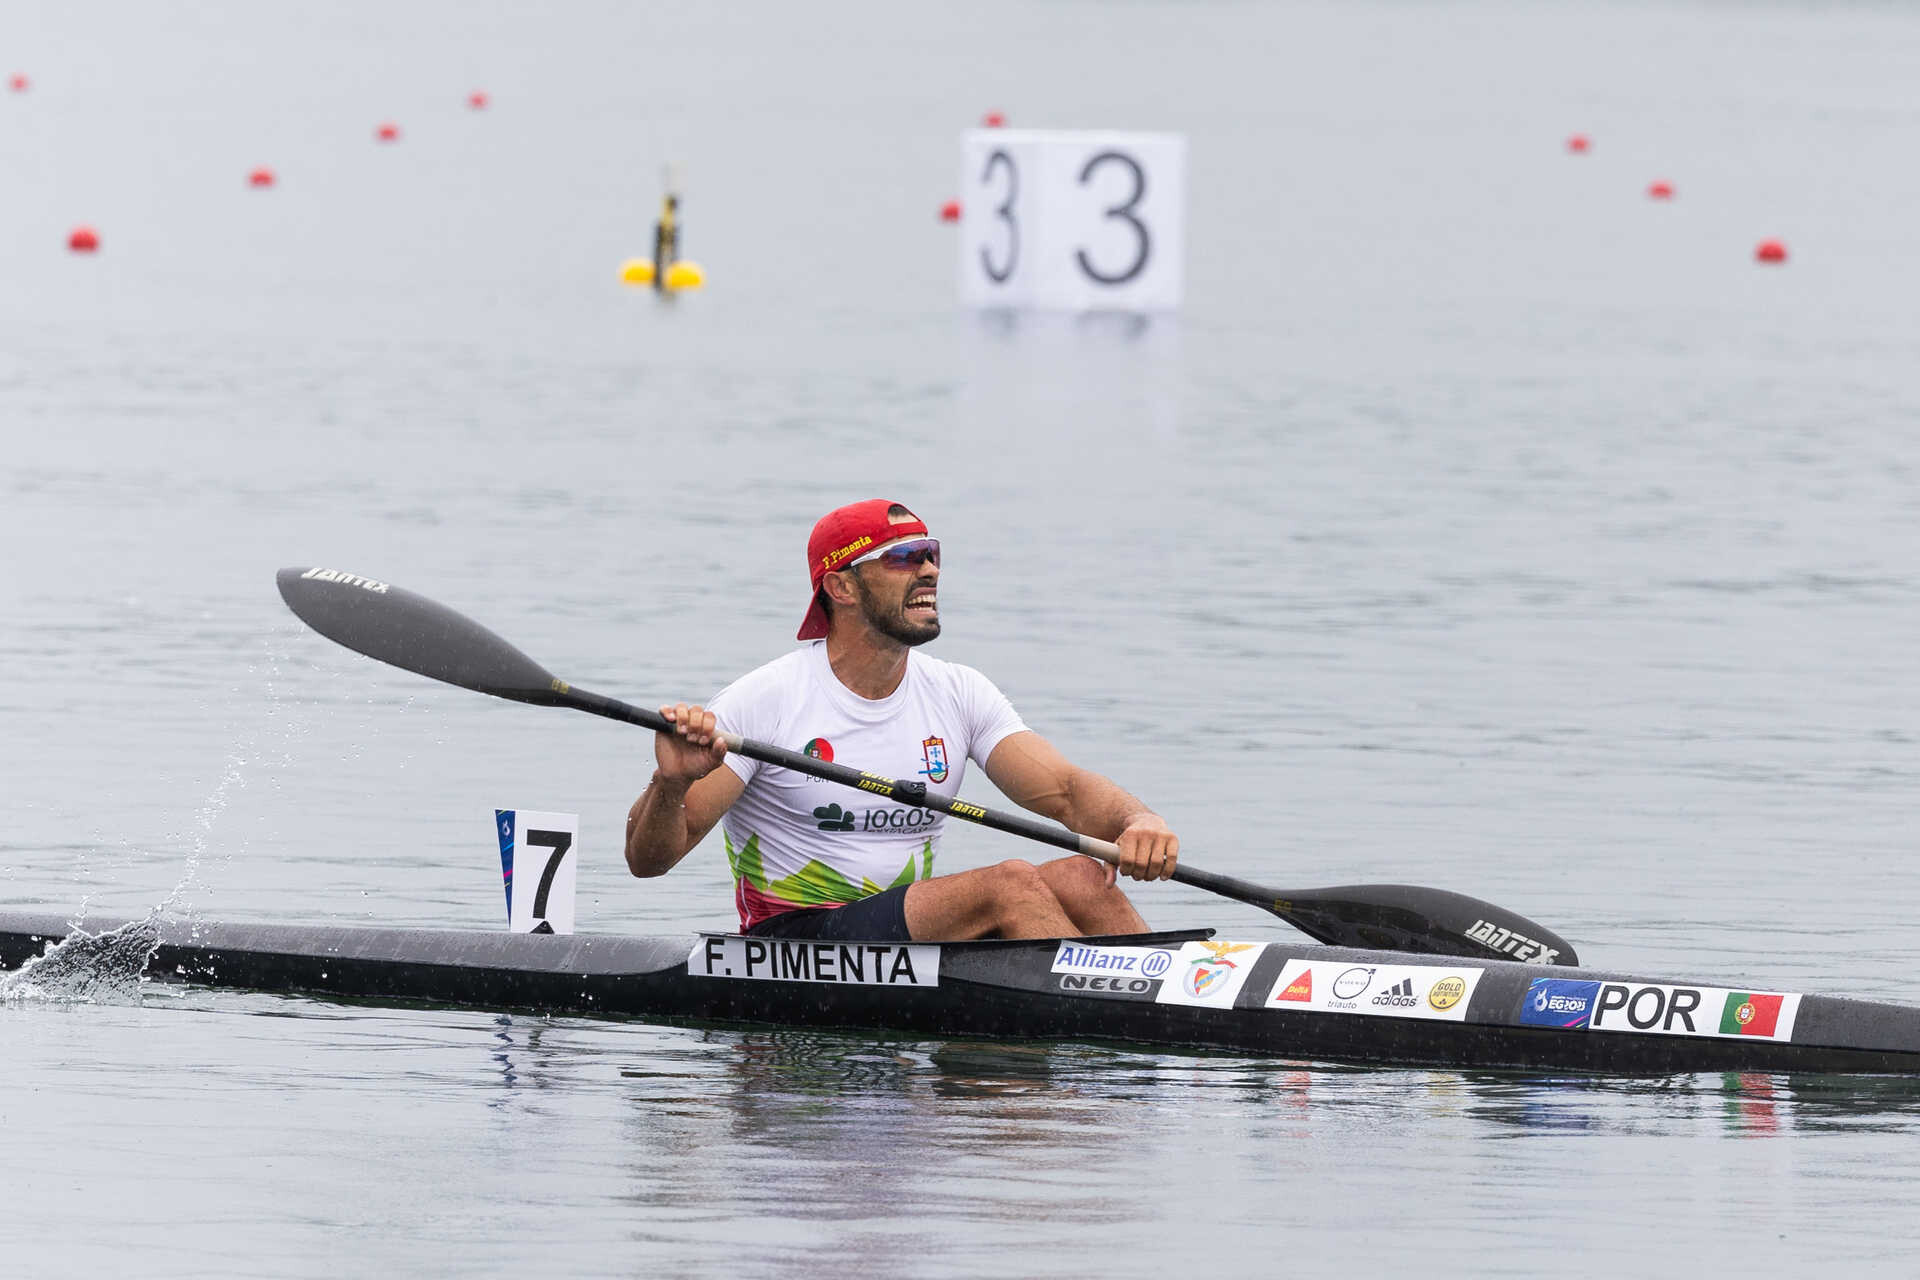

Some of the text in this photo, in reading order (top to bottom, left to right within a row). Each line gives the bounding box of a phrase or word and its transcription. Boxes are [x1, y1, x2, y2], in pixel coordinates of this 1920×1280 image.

[979, 148, 1020, 285] 3
[1074, 150, 1151, 287] 3
[863, 808, 936, 832] JOGOS
[526, 829, 572, 919] 7
[705, 938, 918, 985] F. PIMENTA
[1057, 947, 1138, 971] Allianz
[1062, 975, 1150, 993] NELO
[1438, 982, 1462, 992] GOLD
[1327, 1000, 1358, 1010] triauto
[1371, 994, 1417, 1007] adidas
[1593, 984, 1702, 1032] POR
